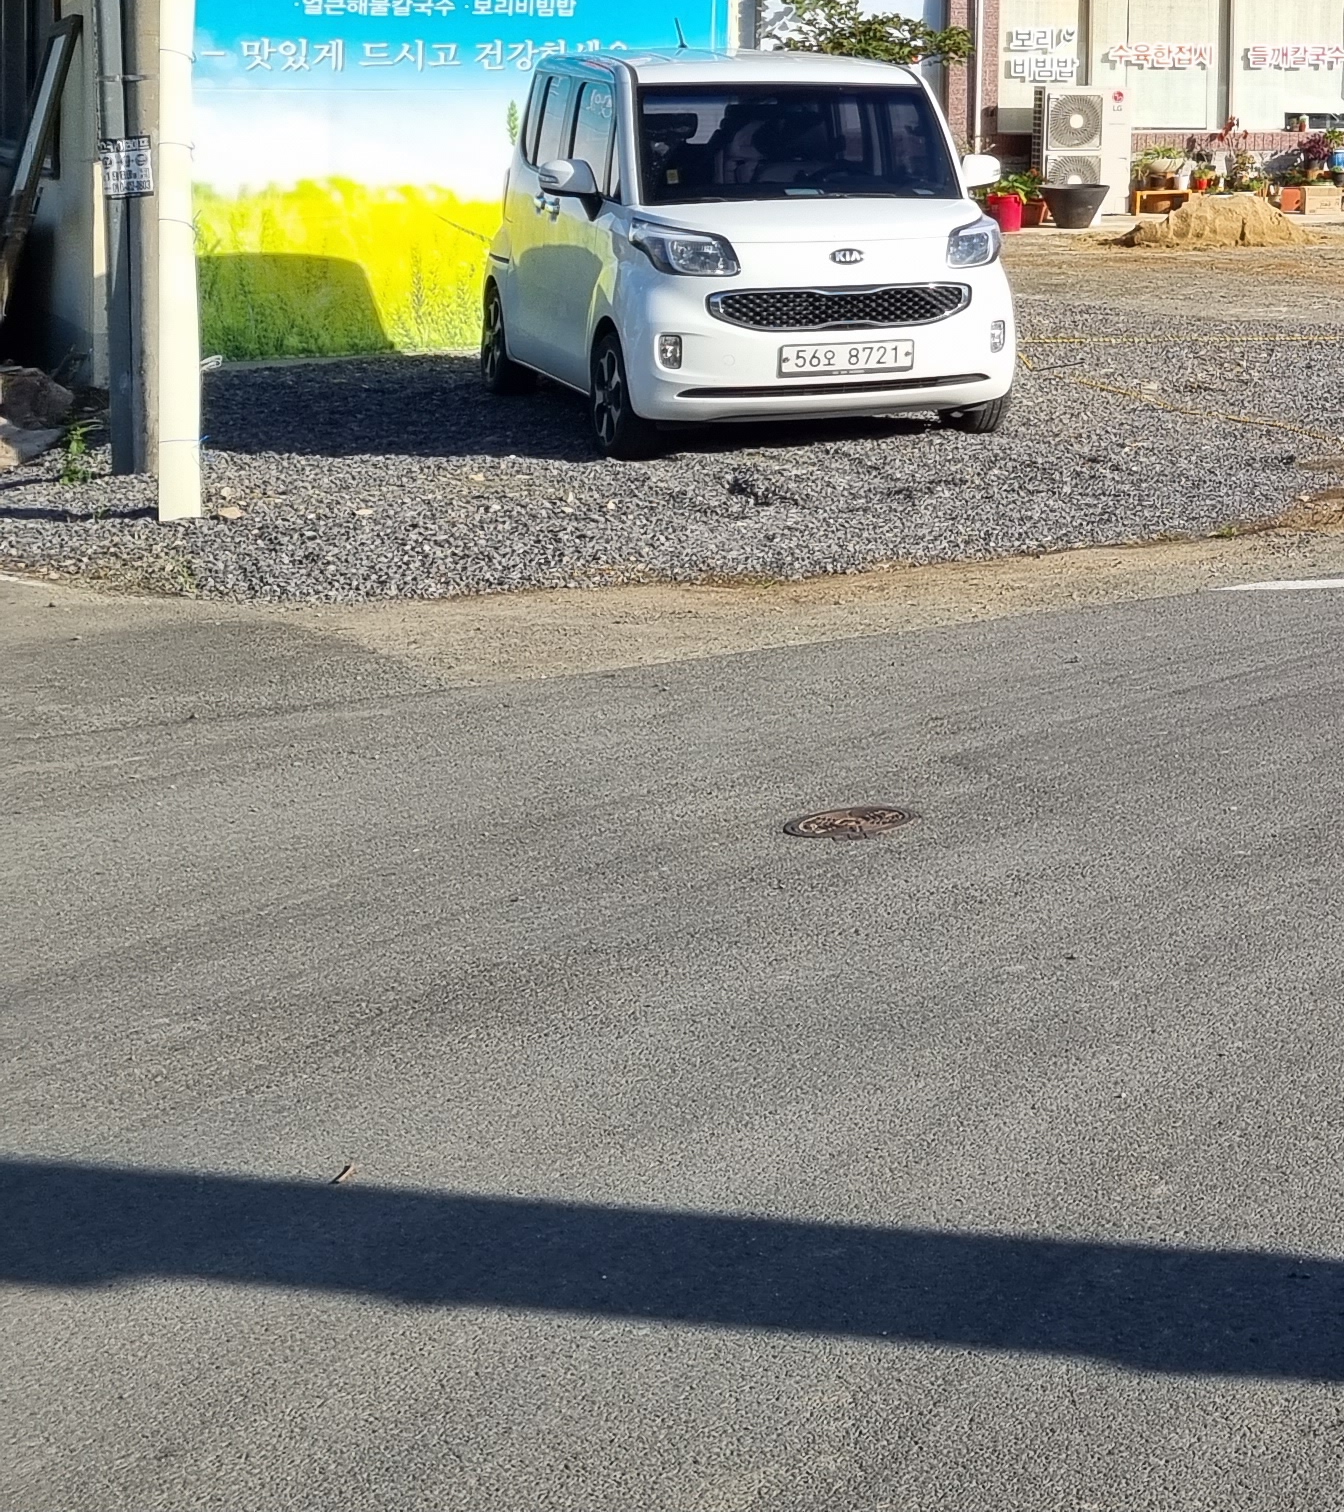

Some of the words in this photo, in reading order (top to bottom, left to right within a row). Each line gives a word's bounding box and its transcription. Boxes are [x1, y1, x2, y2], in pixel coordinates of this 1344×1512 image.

[1013, 29, 1054, 50] 보리
[240, 37, 346, 73] 맛있게
[359, 38, 463, 74] 드시고
[1109, 43, 1214, 68] 수육한접시
[1012, 56, 1079, 80] 비빔밥
[1112, 104, 1123, 113] LG
[835, 250, 861, 262] KIA
[794, 348, 836, 368] 56오
[847, 345, 899, 366] 8721
